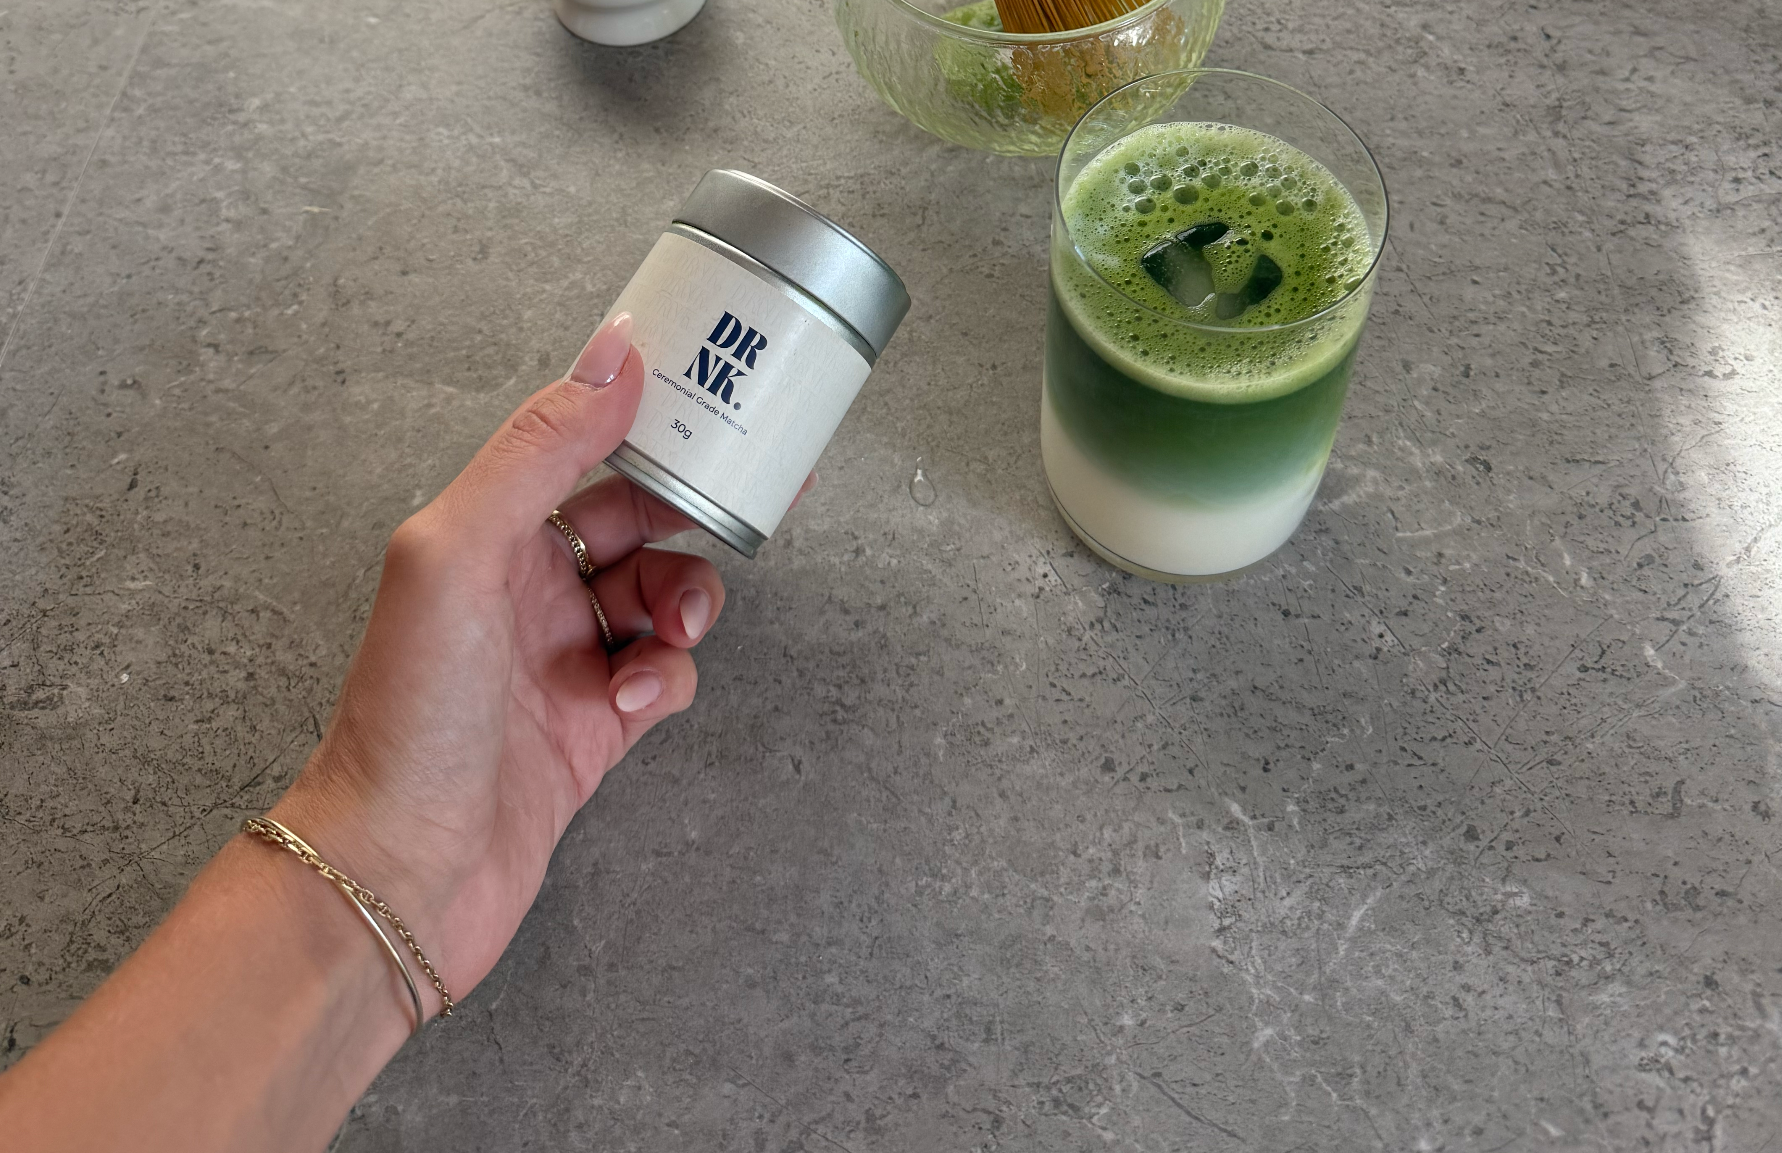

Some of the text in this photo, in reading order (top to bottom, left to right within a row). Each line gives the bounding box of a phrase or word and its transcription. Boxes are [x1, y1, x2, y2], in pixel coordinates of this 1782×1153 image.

[706, 310, 768, 370] DR
[652, 368, 749, 436] Ceremonial Grade Matcha
[683, 345, 749, 411] NK.
[670, 418, 693, 440] 30g
